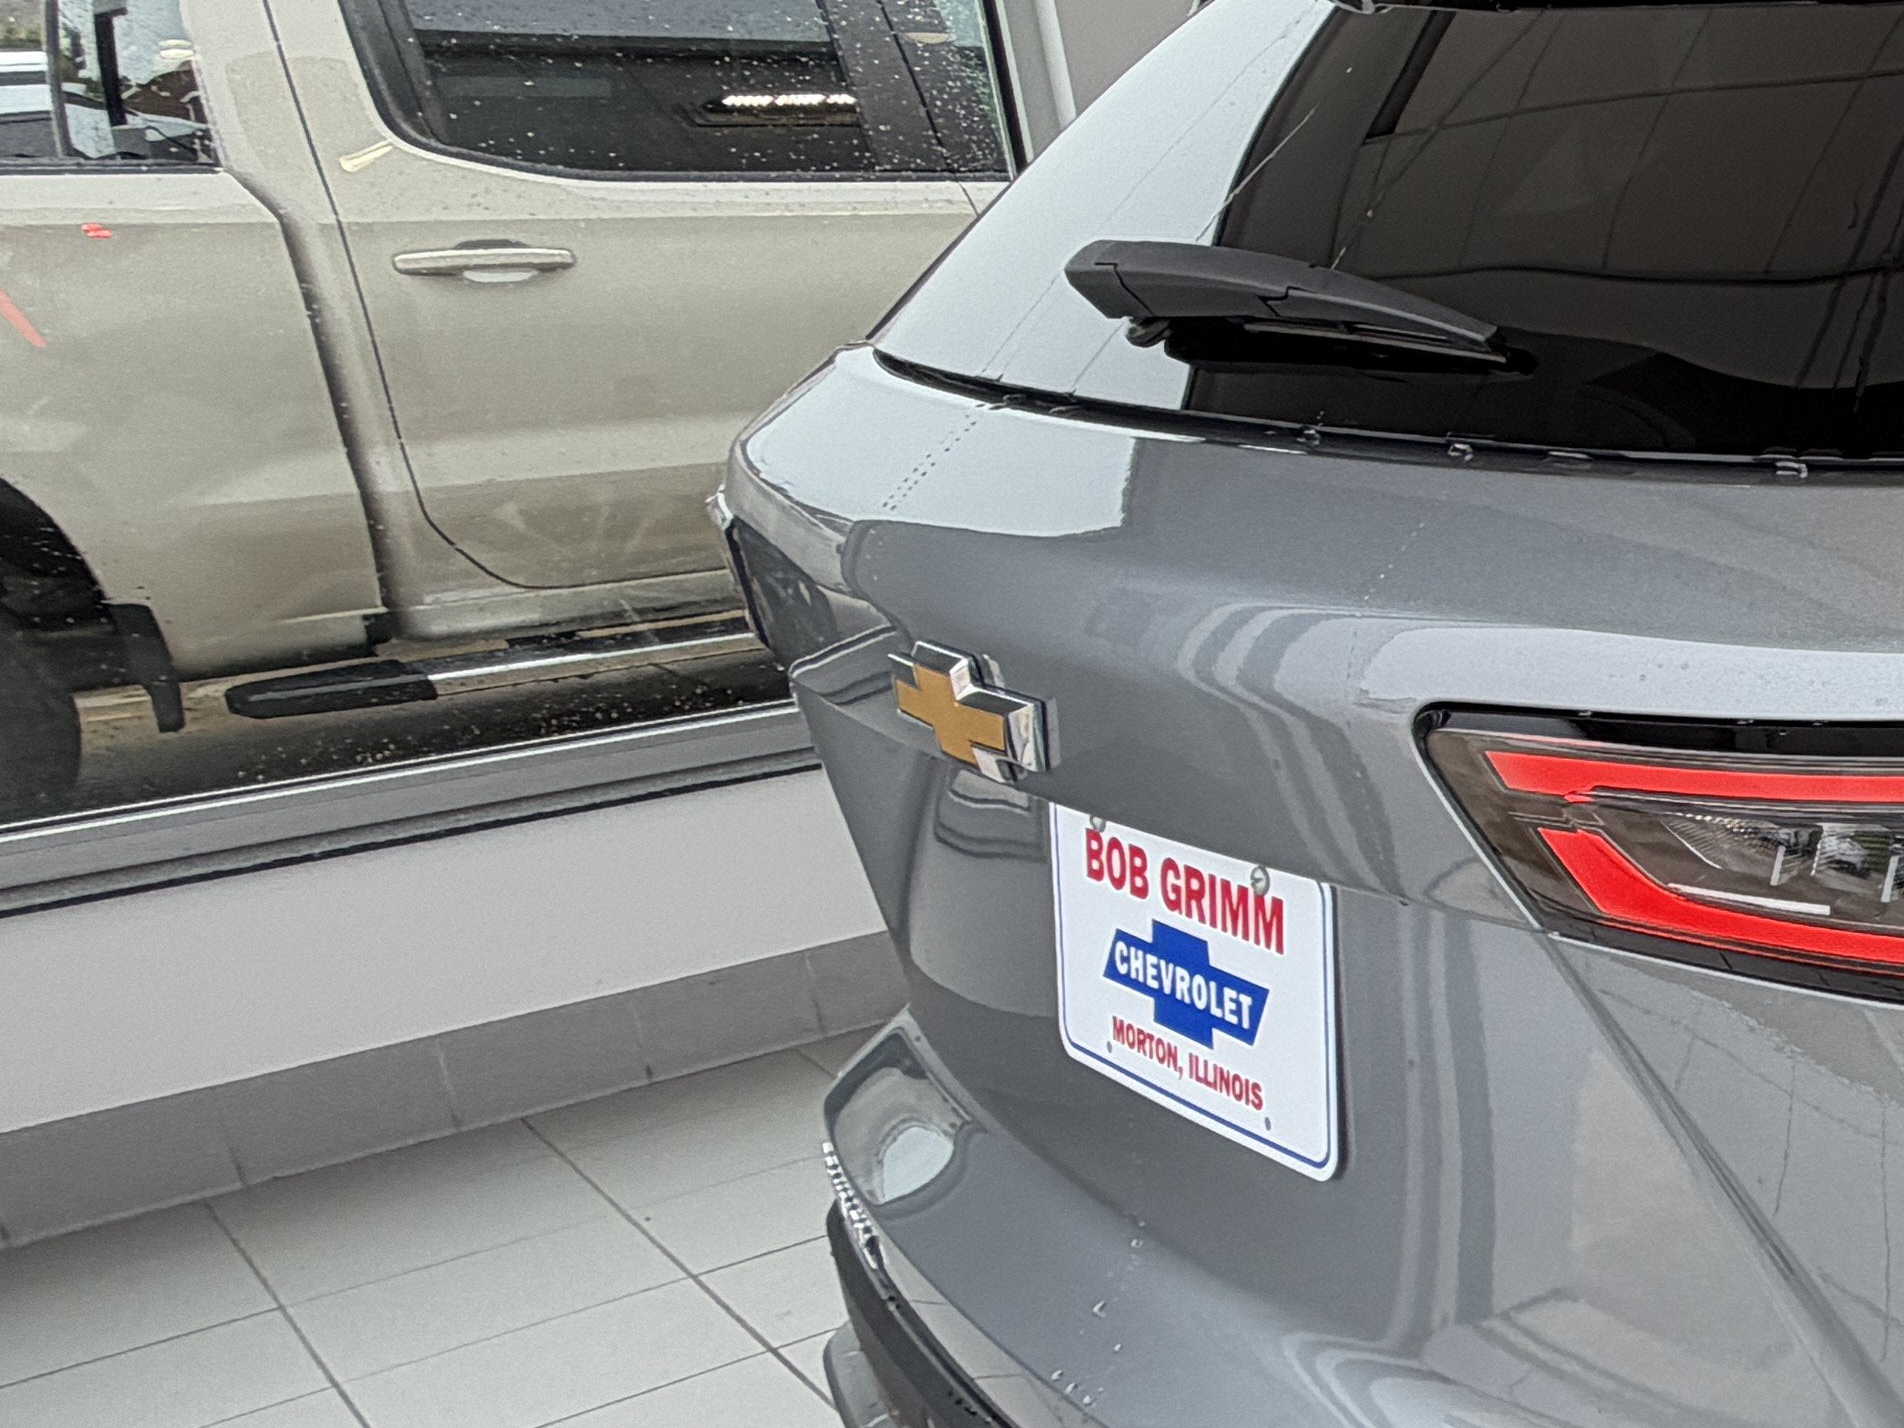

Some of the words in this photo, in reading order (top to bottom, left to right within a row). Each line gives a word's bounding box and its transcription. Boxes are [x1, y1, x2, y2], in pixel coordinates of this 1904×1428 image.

[1085, 827, 1149, 900] BOB
[1160, 857, 1285, 955] GRIMM
[1114, 941, 1254, 1031] CHEVROLET
[1112, 1015, 1183, 1079] MORTON,
[1188, 1052, 1264, 1111] ILLINOIS
